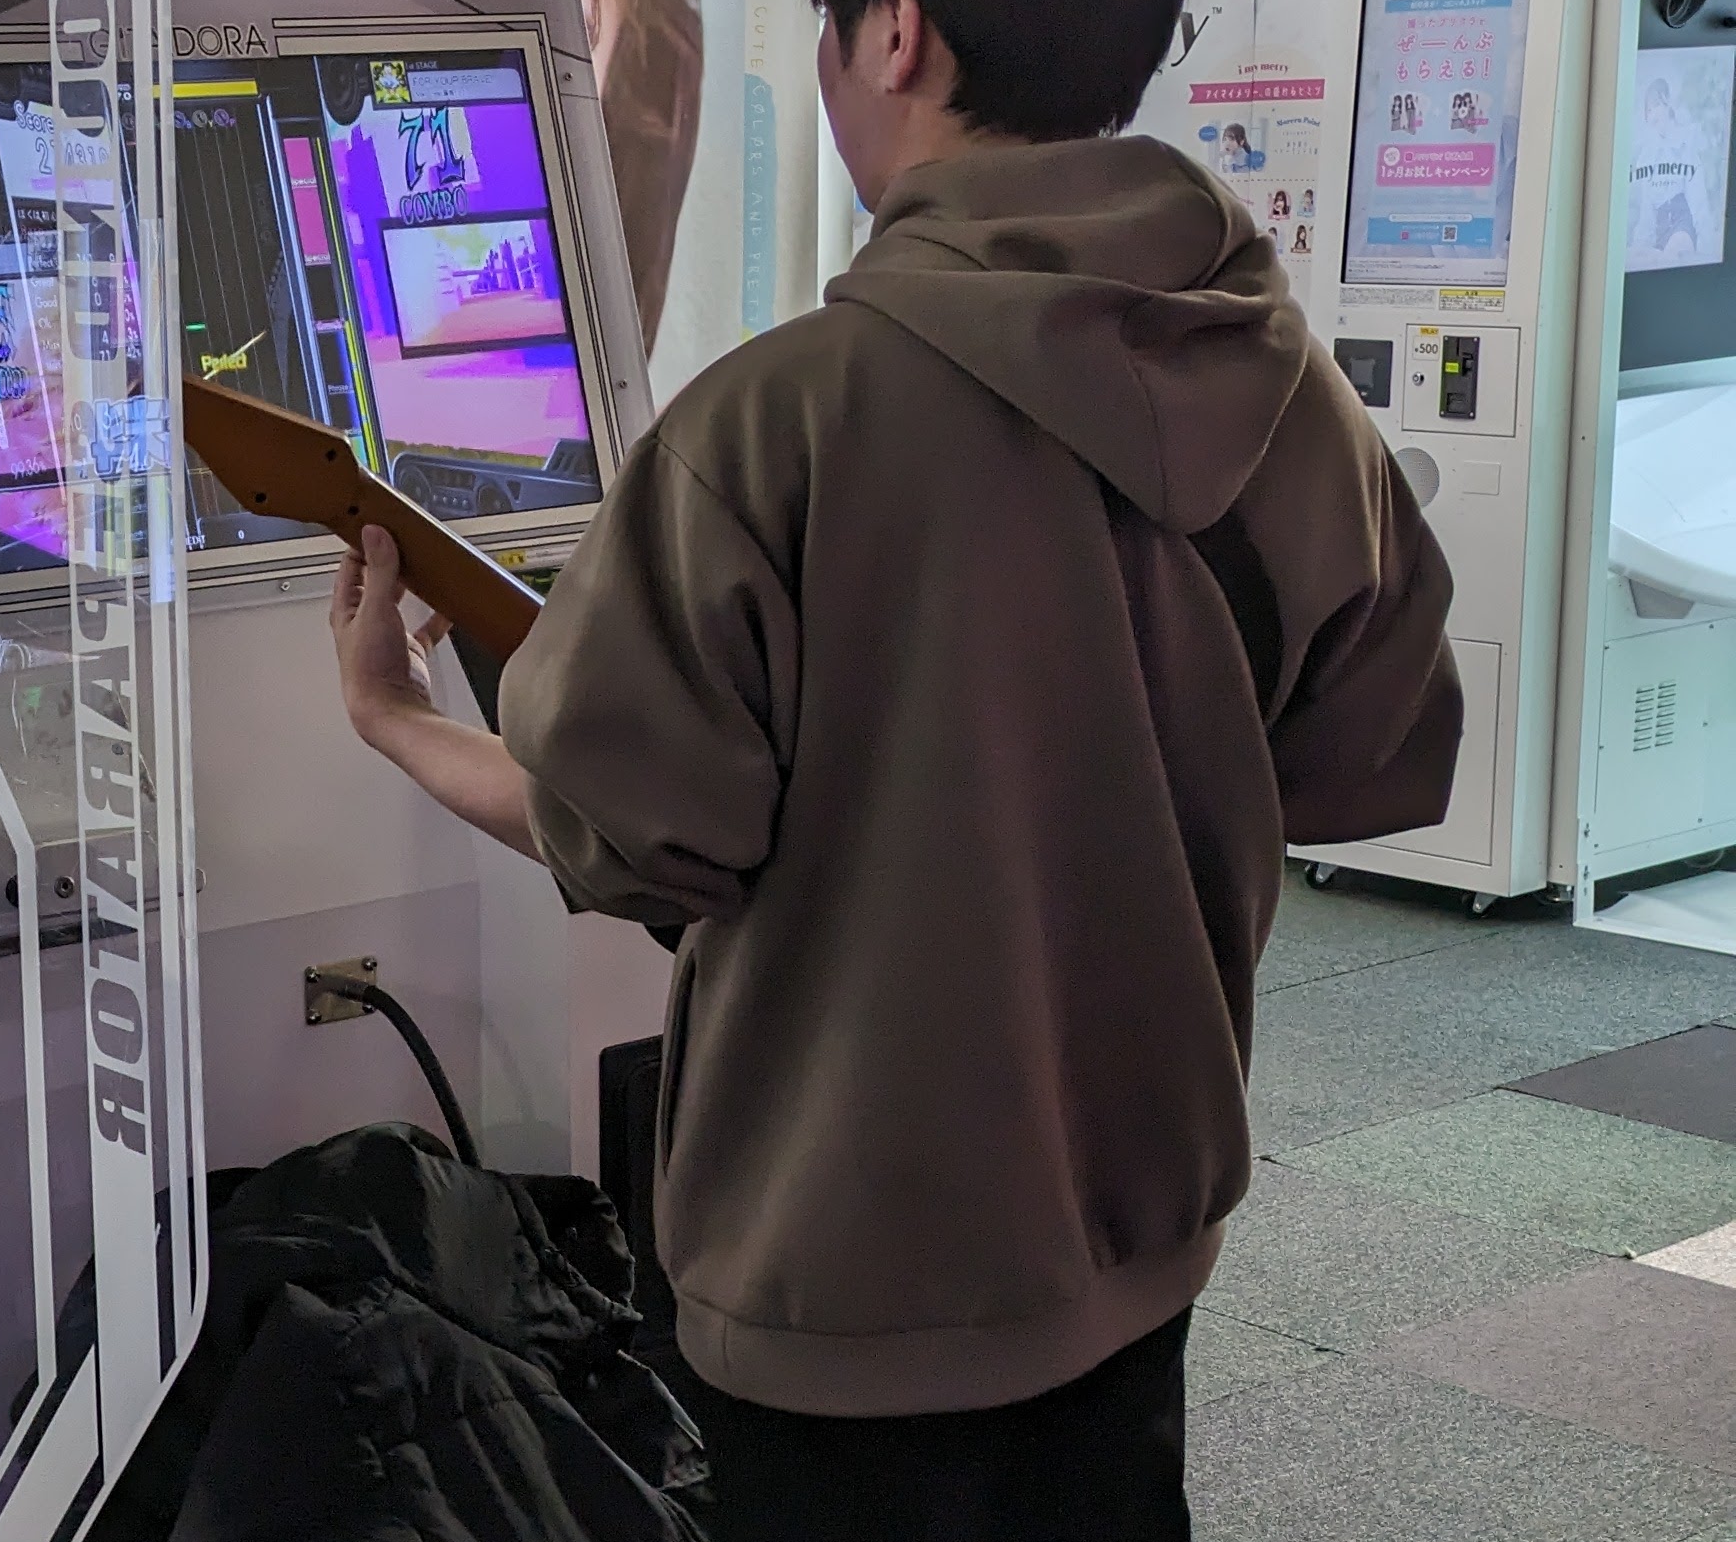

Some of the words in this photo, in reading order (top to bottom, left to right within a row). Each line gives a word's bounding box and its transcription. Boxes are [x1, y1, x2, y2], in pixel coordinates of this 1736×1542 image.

[398, 106, 466, 191] 71
[1635, 163, 1655, 183] my
[1657, 162, 1698, 182] merry
[399, 184, 468, 225] COMBO
